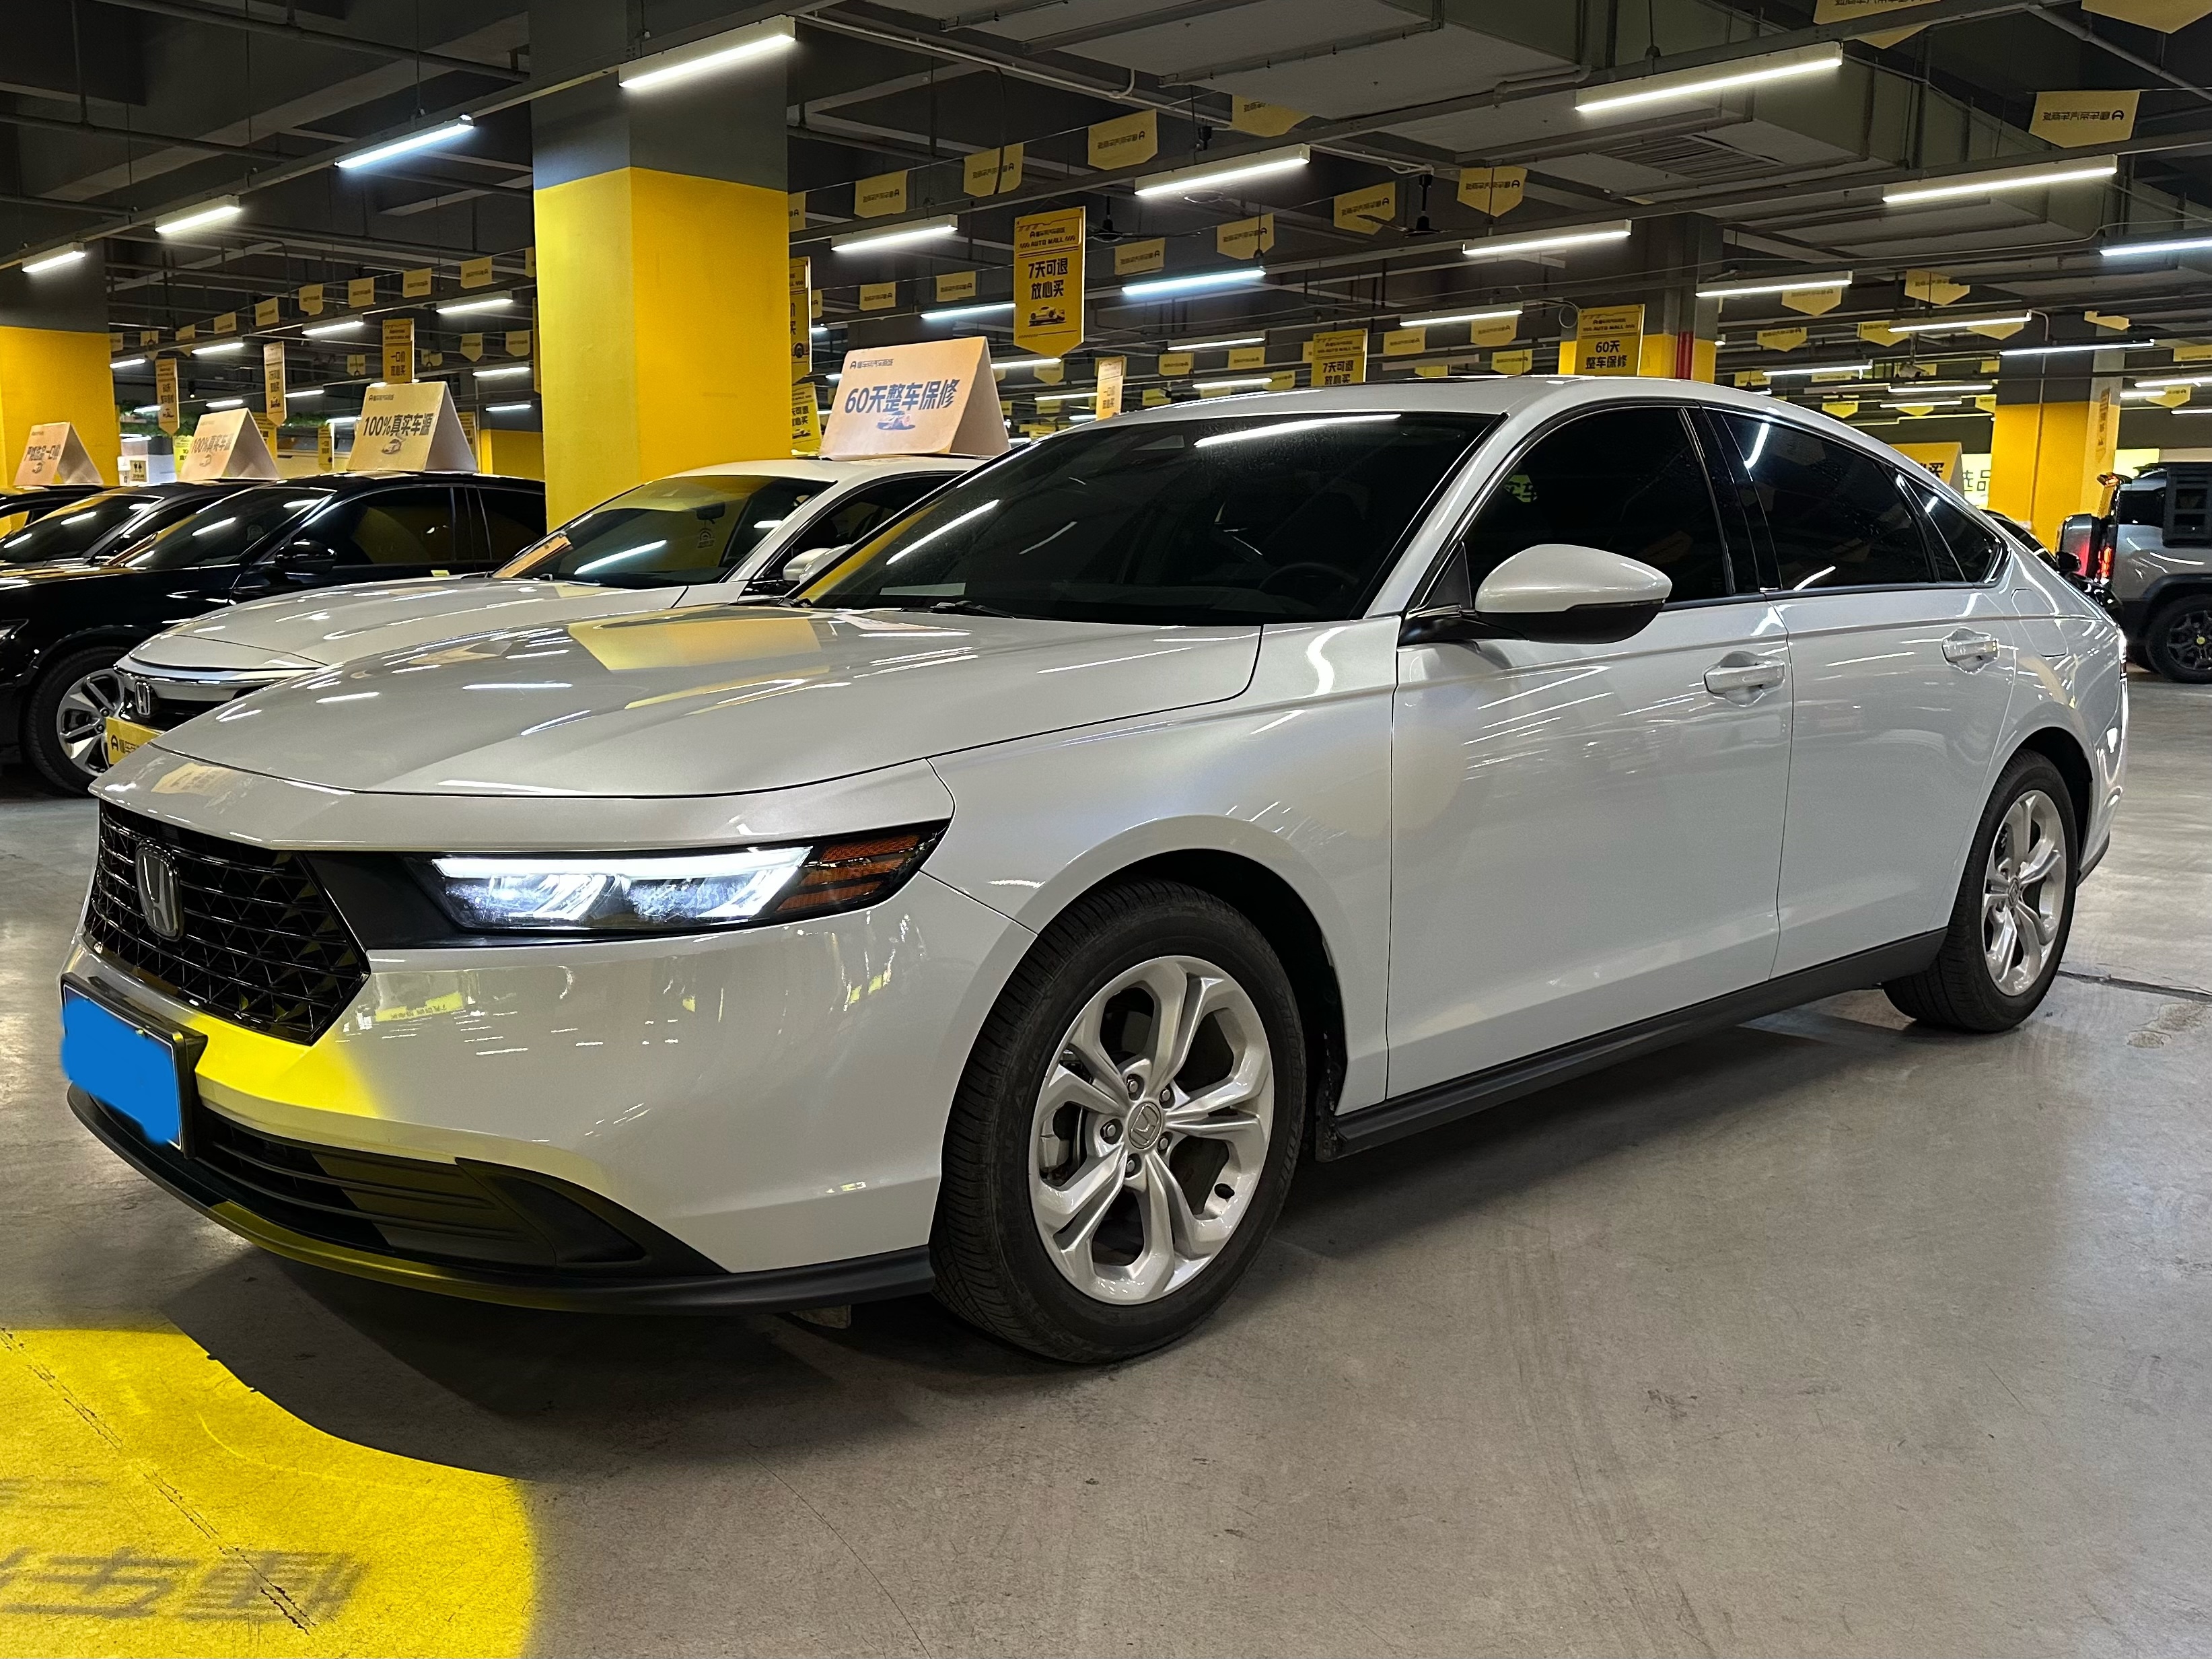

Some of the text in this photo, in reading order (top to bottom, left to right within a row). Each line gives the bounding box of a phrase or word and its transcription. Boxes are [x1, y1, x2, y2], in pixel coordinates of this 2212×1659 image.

[1028, 257, 1069, 279] 7天可退
[1031, 279, 1064, 300] 放心买
[1596, 340, 1620, 353] 60天
[1323, 360, 1354, 374] 7天可退
[1585, 355, 1627, 369] 整车保修
[845, 379, 960, 413] 60天整车保修
[363, 412, 435, 436] 100%真实车源
